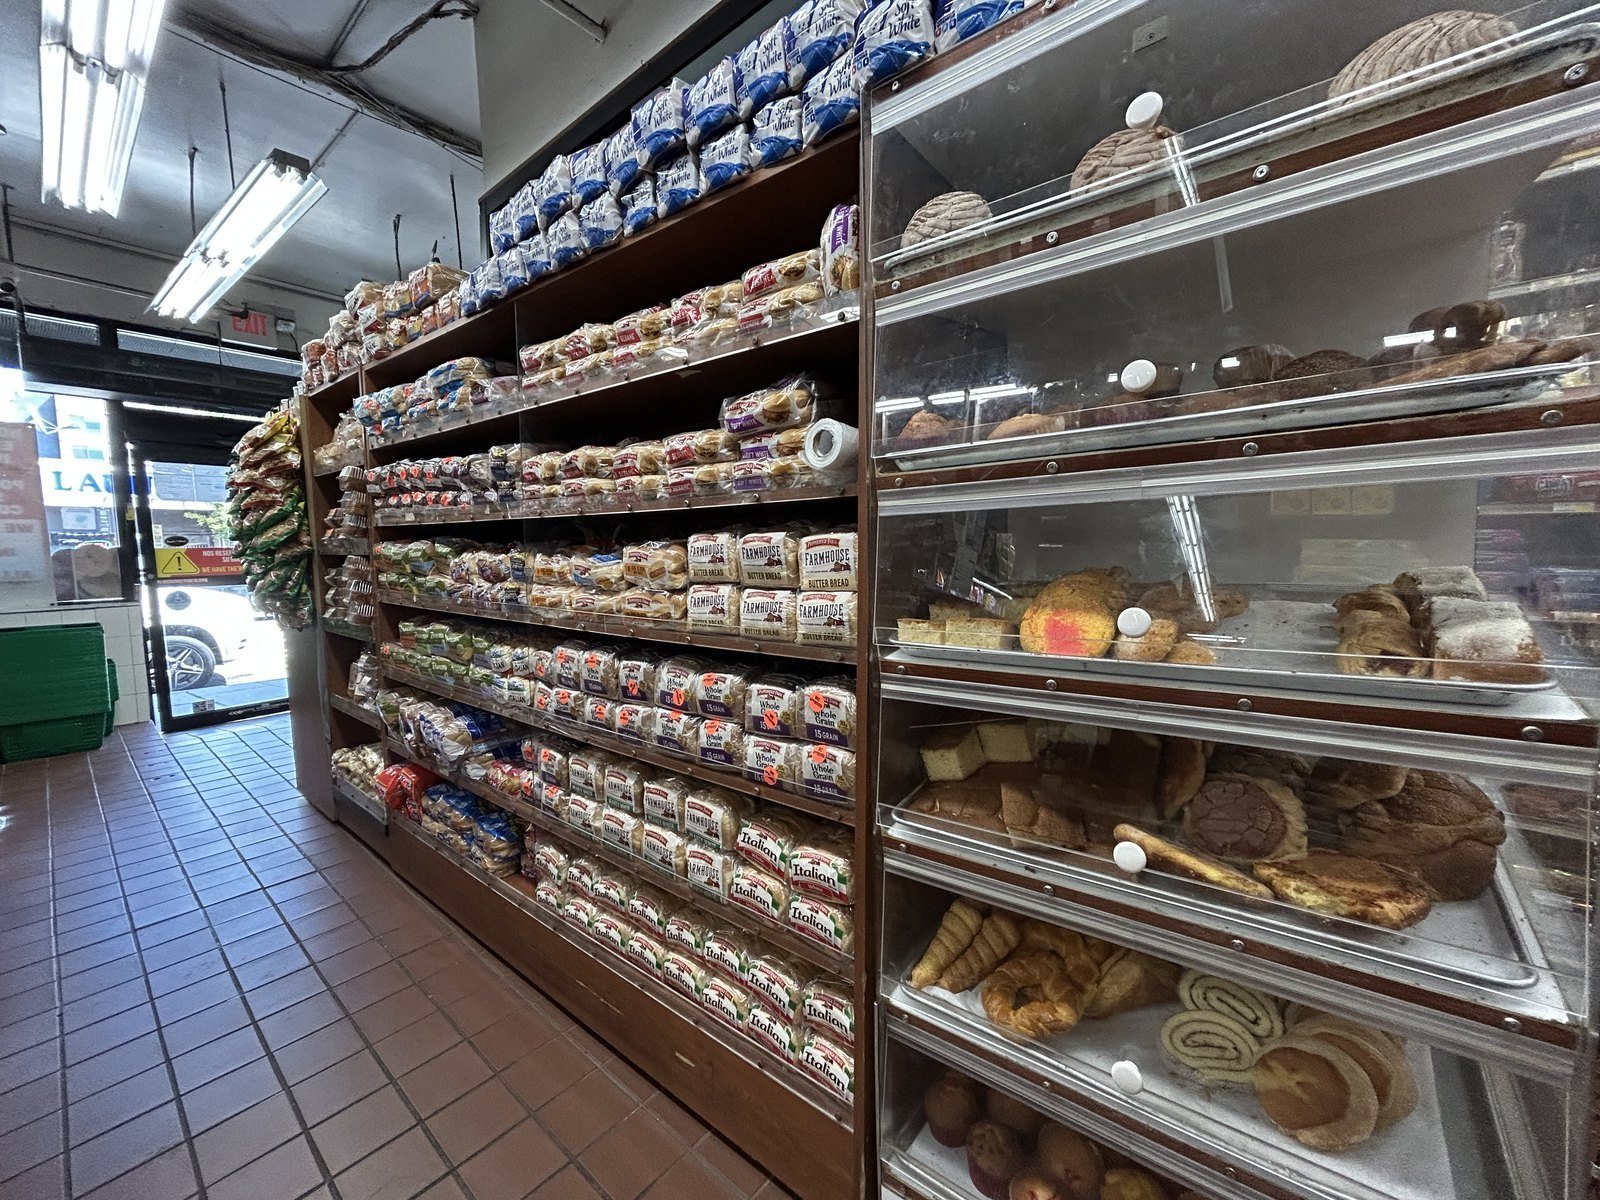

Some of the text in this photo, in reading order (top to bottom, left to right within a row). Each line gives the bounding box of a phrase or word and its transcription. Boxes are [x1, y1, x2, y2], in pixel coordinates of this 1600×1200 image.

[816, 14, 841, 36] White
[889, 17, 921, 39] White
[763, 35, 777, 54] Soft
[759, 51, 782, 72] White
[707, 85, 728, 103] White
[776, 99, 793, 115] Soft
[654, 111, 673, 128] White
[773, 117, 795, 132] White
[718, 146, 739, 160] White
[675, 157, 688, 173] Soft
[671, 172, 691, 187] White
[231, 312, 268, 336] EXIT
[742, 419, 758, 428] WHITE
[690, 544, 725, 557] FARMHOUSE
[742, 545, 781, 560] FARMHOUSE
[805, 549, 850, 566] FARMHOUSE
[693, 569, 724, 577] BUTTER BREAD
[747, 572, 782, 580] BUTTER BREAD
[808, 579, 849, 588] BUTTER BREAD
[690, 595, 725, 608] FARMHOUSE
[743, 601, 783, 614] FARMHOUSE
[800, 603, 844, 619] FARMHOUSE
[668, 678, 684, 687] Whole
[705, 686, 722, 695] Whole
[706, 692, 721, 701] Grain
[707, 704, 712, 712] 15
[760, 701, 780, 710] Whole
[814, 710, 837, 719] Whole
[815, 717, 835, 727] Grain
[706, 733, 723, 741] Whole
[706, 739, 722, 748] Grain
[815, 730, 838, 741] 15 GRAIN
[707, 751, 712, 759] 15
[756, 753, 776, 763] Whole
[811, 764, 834, 774] Whole
[812, 772, 833, 782] Grain
[687, 811, 719, 833] FARMHOUSE
[740, 832, 778, 862] Italian
[688, 862, 720, 881] ARMHOUSE
[793, 864, 836, 887] Italian
[734, 883, 770, 910] Italian
[565, 909, 587, 928] Italian
[630, 903, 657, 928] Italian
[791, 907, 832, 938] Italian
[595, 926, 620, 946] Italian
[666, 929, 694, 950] Italian
[629, 943, 656, 970] Italian
[705, 945, 738, 974] Italian
[665, 966, 694, 993] Italian
[750, 972, 786, 1010] Italian
[703, 994, 736, 1022] Italian
[807, 1003, 848, 1034] Italian
[751, 1013, 787, 1051] Italian
[805, 1050, 846, 1092] Italian
